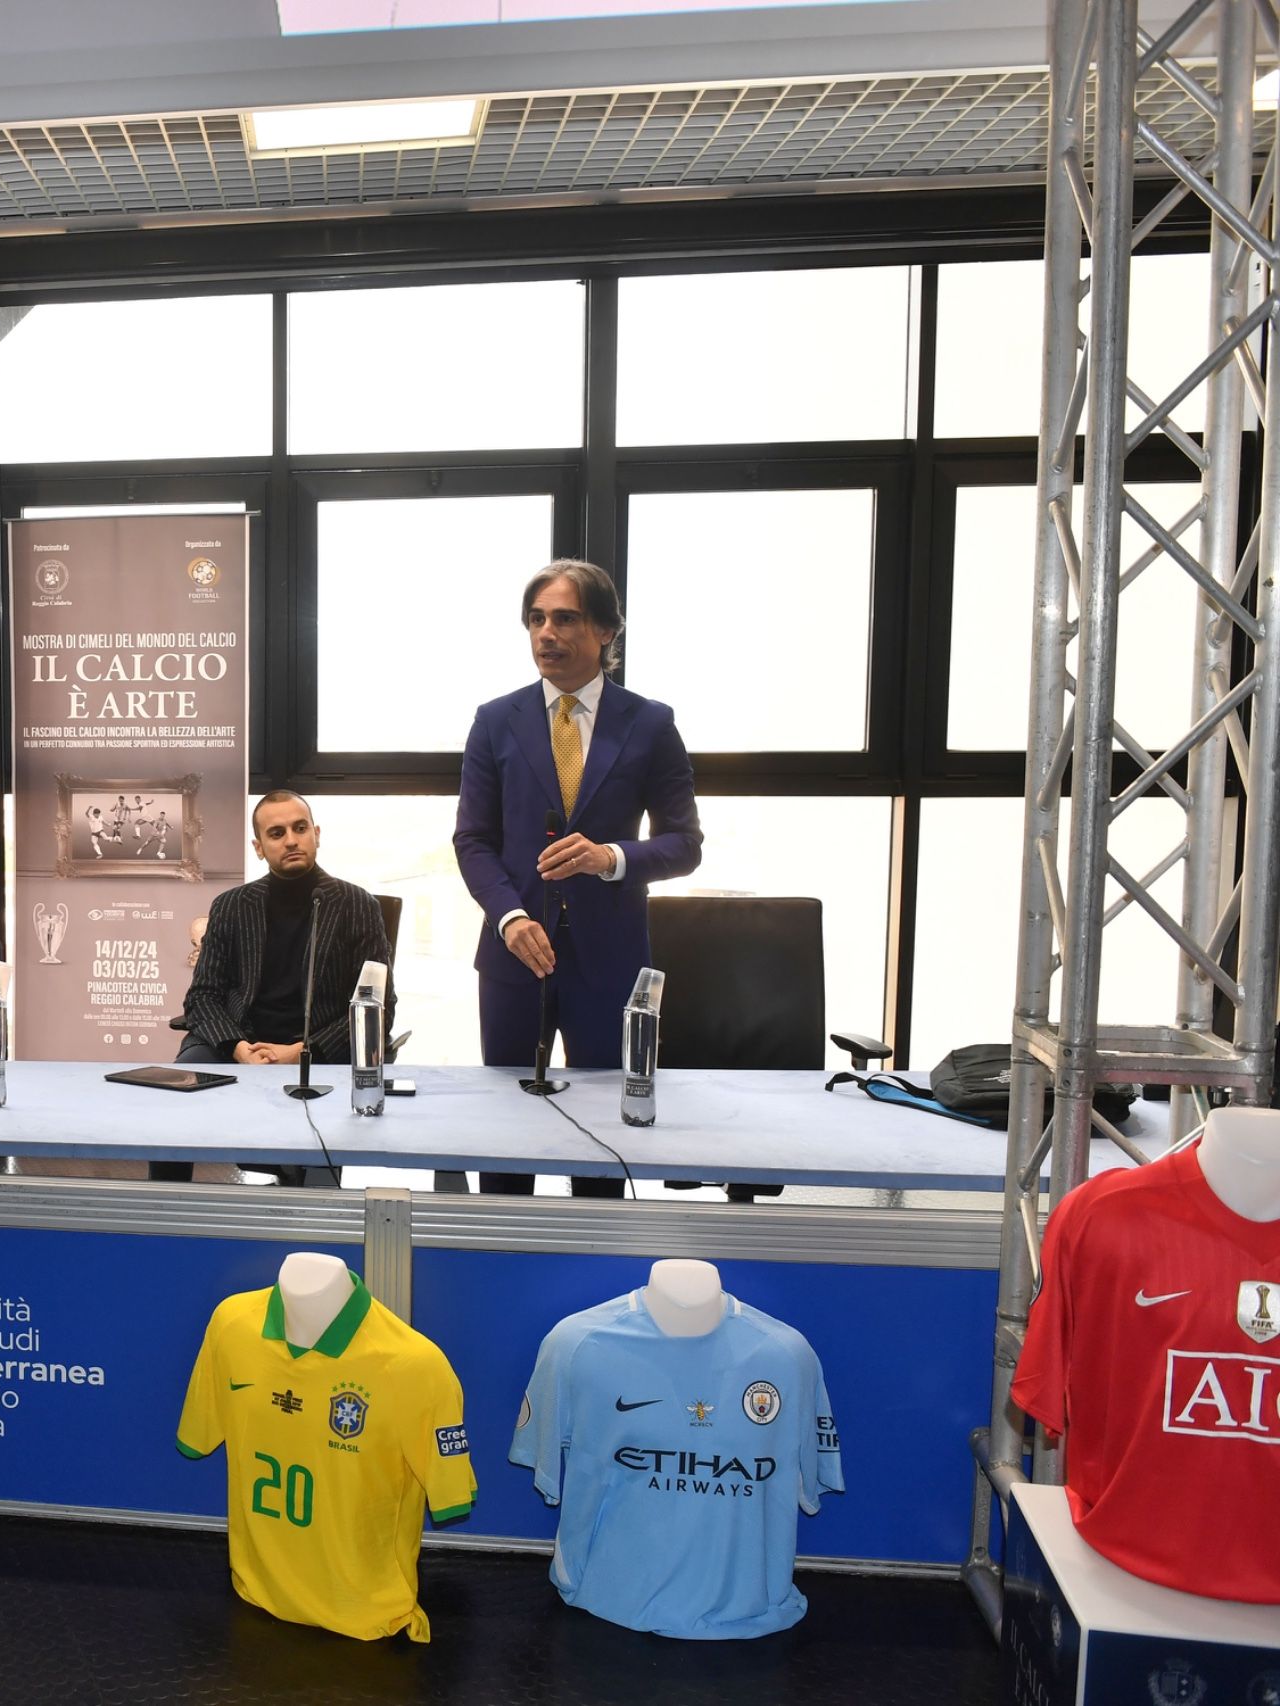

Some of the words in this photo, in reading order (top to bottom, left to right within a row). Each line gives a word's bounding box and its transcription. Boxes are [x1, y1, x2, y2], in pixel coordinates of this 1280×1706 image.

[23, 634, 64, 649] MOSTRA
[65, 634, 76, 649] DI
[79, 633, 113, 649] CIMELI
[115, 633, 135, 648] DEL
[136, 632, 176, 648] MONDO
[178, 632, 198, 648] DEL
[199, 632, 237, 648] CALCIO
[32, 655, 67, 682] IL
[76, 653, 228, 682] CALCIO
[67, 683, 90, 719] È
[96, 690, 198, 719] ARTE
[23, 727, 31, 738] IL
[31, 726, 62, 738] FASCINO
[63, 726, 78, 738] DEL
[79, 726, 106, 738] CALCIO
[107, 726, 146, 738] INCONTRA
[147, 726, 158, 737] LA
[159, 726, 196, 737] BELLEZZA
[197, 725, 236, 737] DELL'ARTE
[39, 740, 65, 748] PERFETTO
[94, 740, 105, 748] TRA
[105, 740, 132, 748] PASSIONE
[133, 740, 160, 748] SPORTIVA
[160, 740, 168, 748] ED
[168, 740, 206, 748] ESPRESSIONE
[206, 739, 235, 748] ARTISTICA
[95, 940, 158, 959] 14/12/24
[92, 960, 160, 979] 03/03/25
[87, 981, 139, 994] PINACOTECA
[140, 982, 168, 995] CIVICA
[90, 993, 121, 1005] REGGIO
[122, 994, 164, 1006] CALABRIA
[1251, 1319, 1272, 1329] FIFA
[1175, 1361, 1280, 1432] AI
[438, 1429, 467, 1441] Cree
[328, 1440, 361, 1454] BRASIL
[441, 1439, 469, 1454] gran
[614, 1446, 777, 1482] ETIHAD
[252, 1451, 314, 1528] 20
[648, 1476, 753, 1497] AIRWAYS
